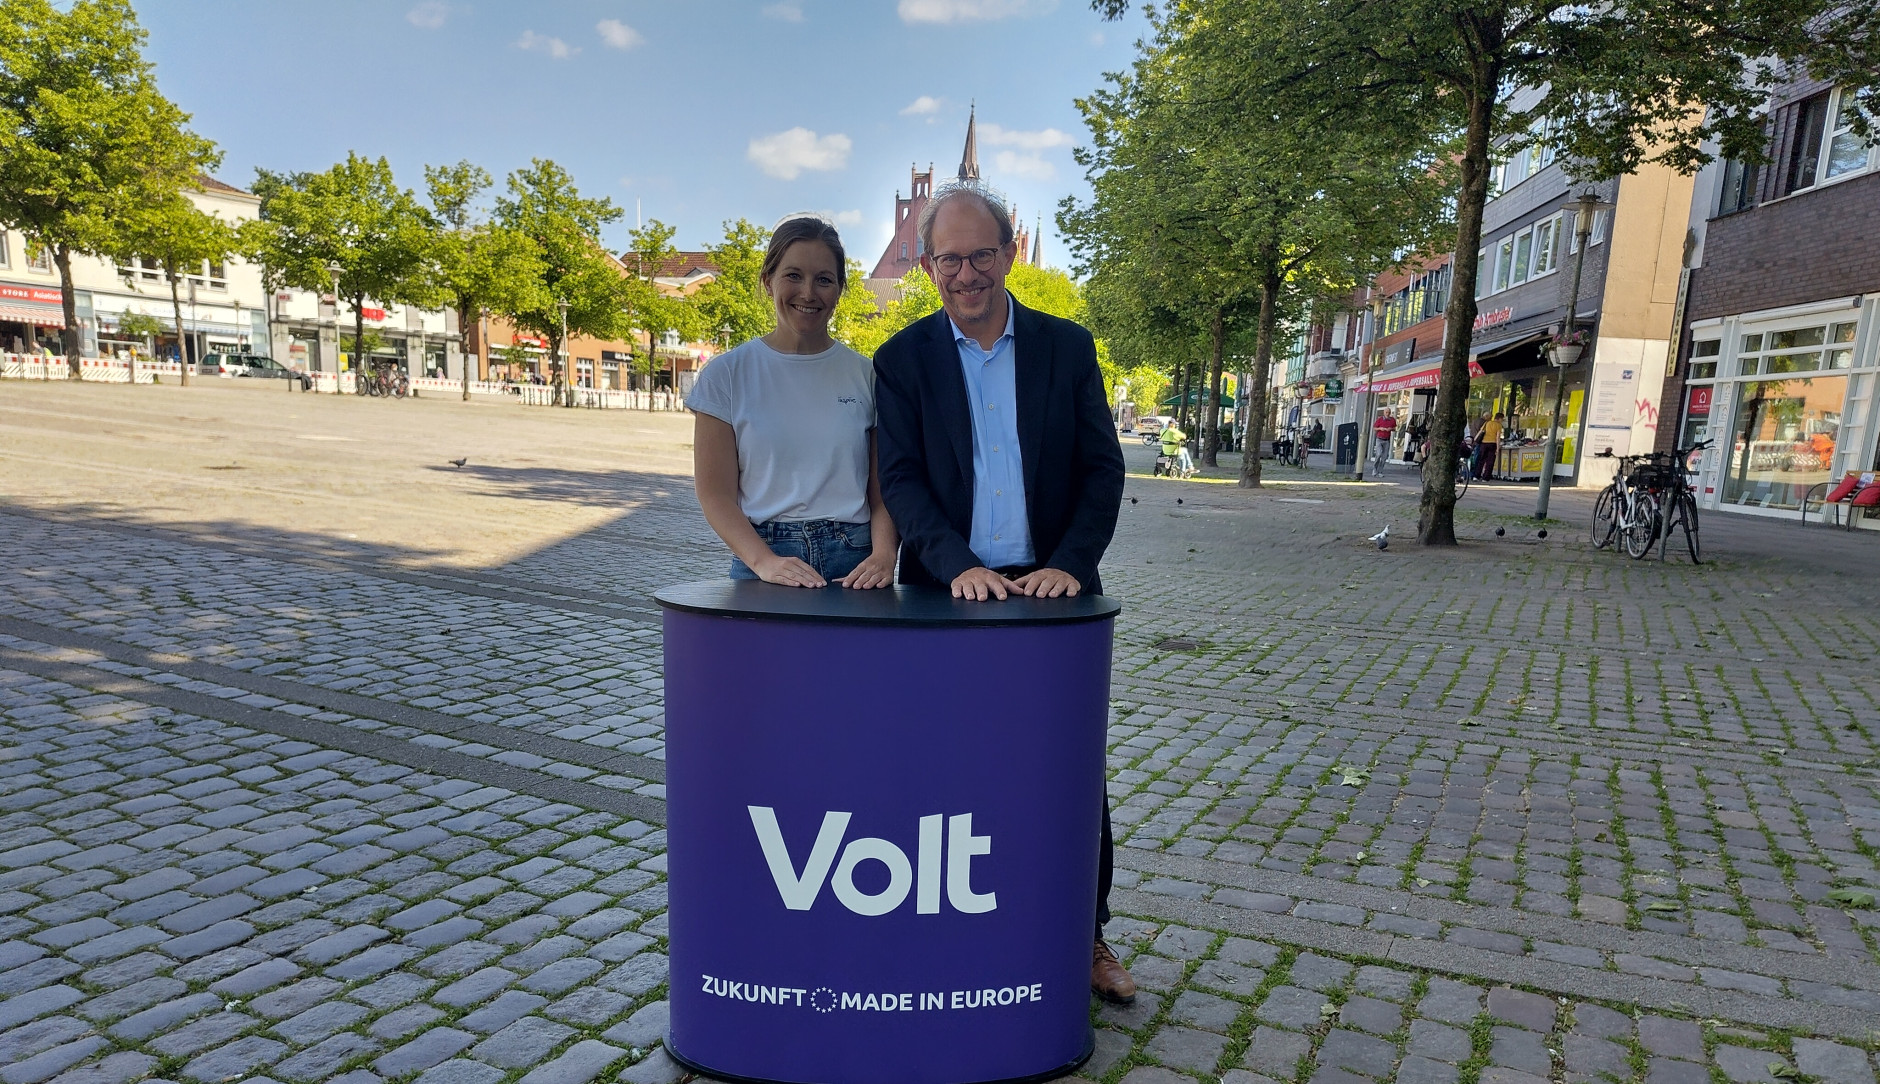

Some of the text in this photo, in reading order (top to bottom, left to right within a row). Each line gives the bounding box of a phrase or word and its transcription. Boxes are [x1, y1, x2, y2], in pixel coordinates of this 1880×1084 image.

[2, 288, 29, 298] STORE
[1668, 271, 1689, 374] EINHORNHAUS
[1409, 374, 1433, 387] SUPERSALE
[747, 805, 998, 917] Volt
[701, 974, 1042, 1012] ZUKUNFT MADE IN EUROPE
